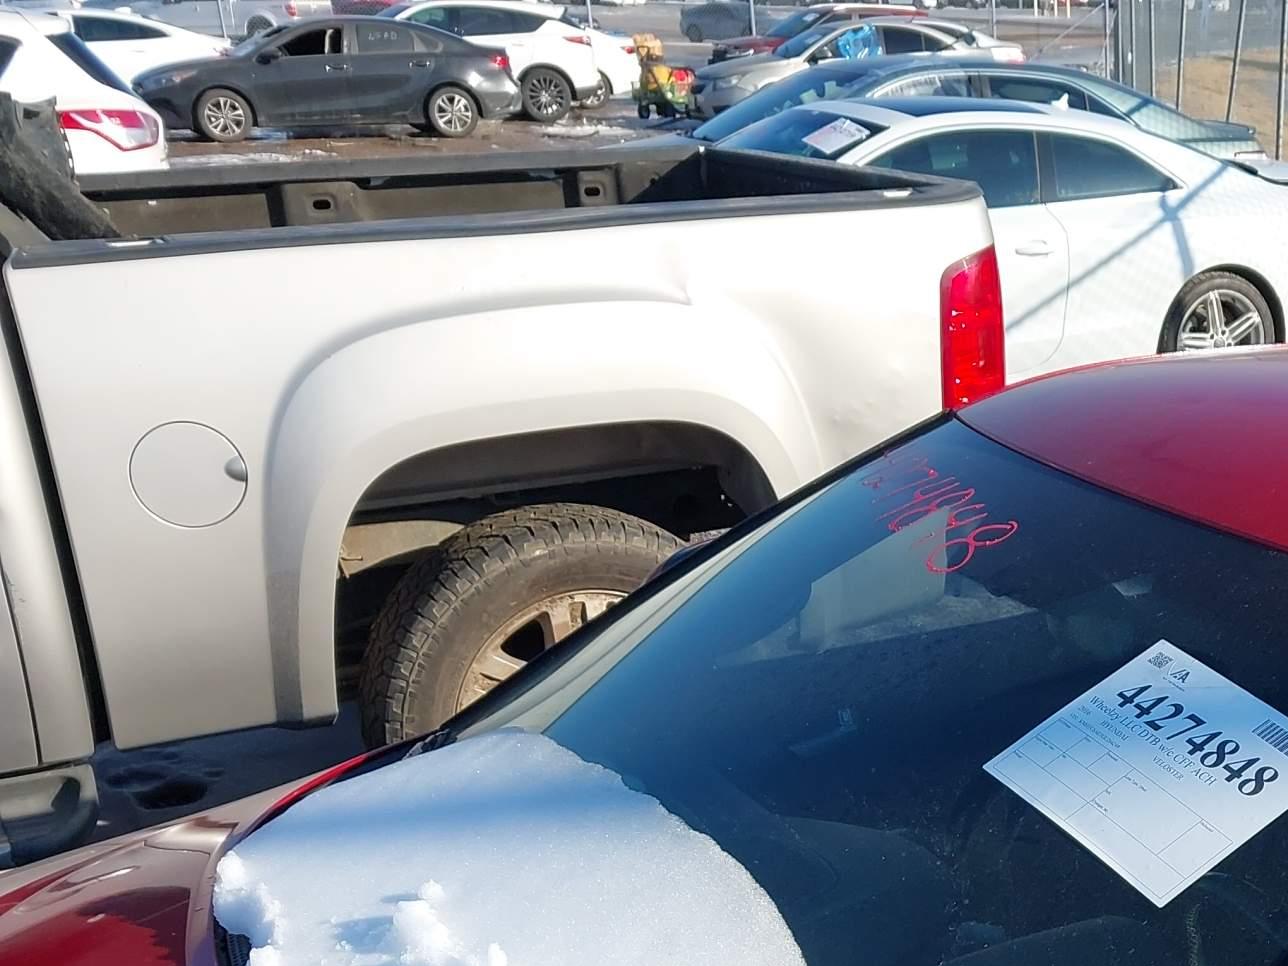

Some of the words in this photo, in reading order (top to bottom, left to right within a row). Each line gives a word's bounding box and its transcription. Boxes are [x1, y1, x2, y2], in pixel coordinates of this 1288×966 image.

[1088, 695, 1121, 722] Wheelzy
[1191, 765, 1218, 786] ACH
[1116, 684, 1280, 797] 44274848
[1152, 755, 1185, 781] VELOSTER
